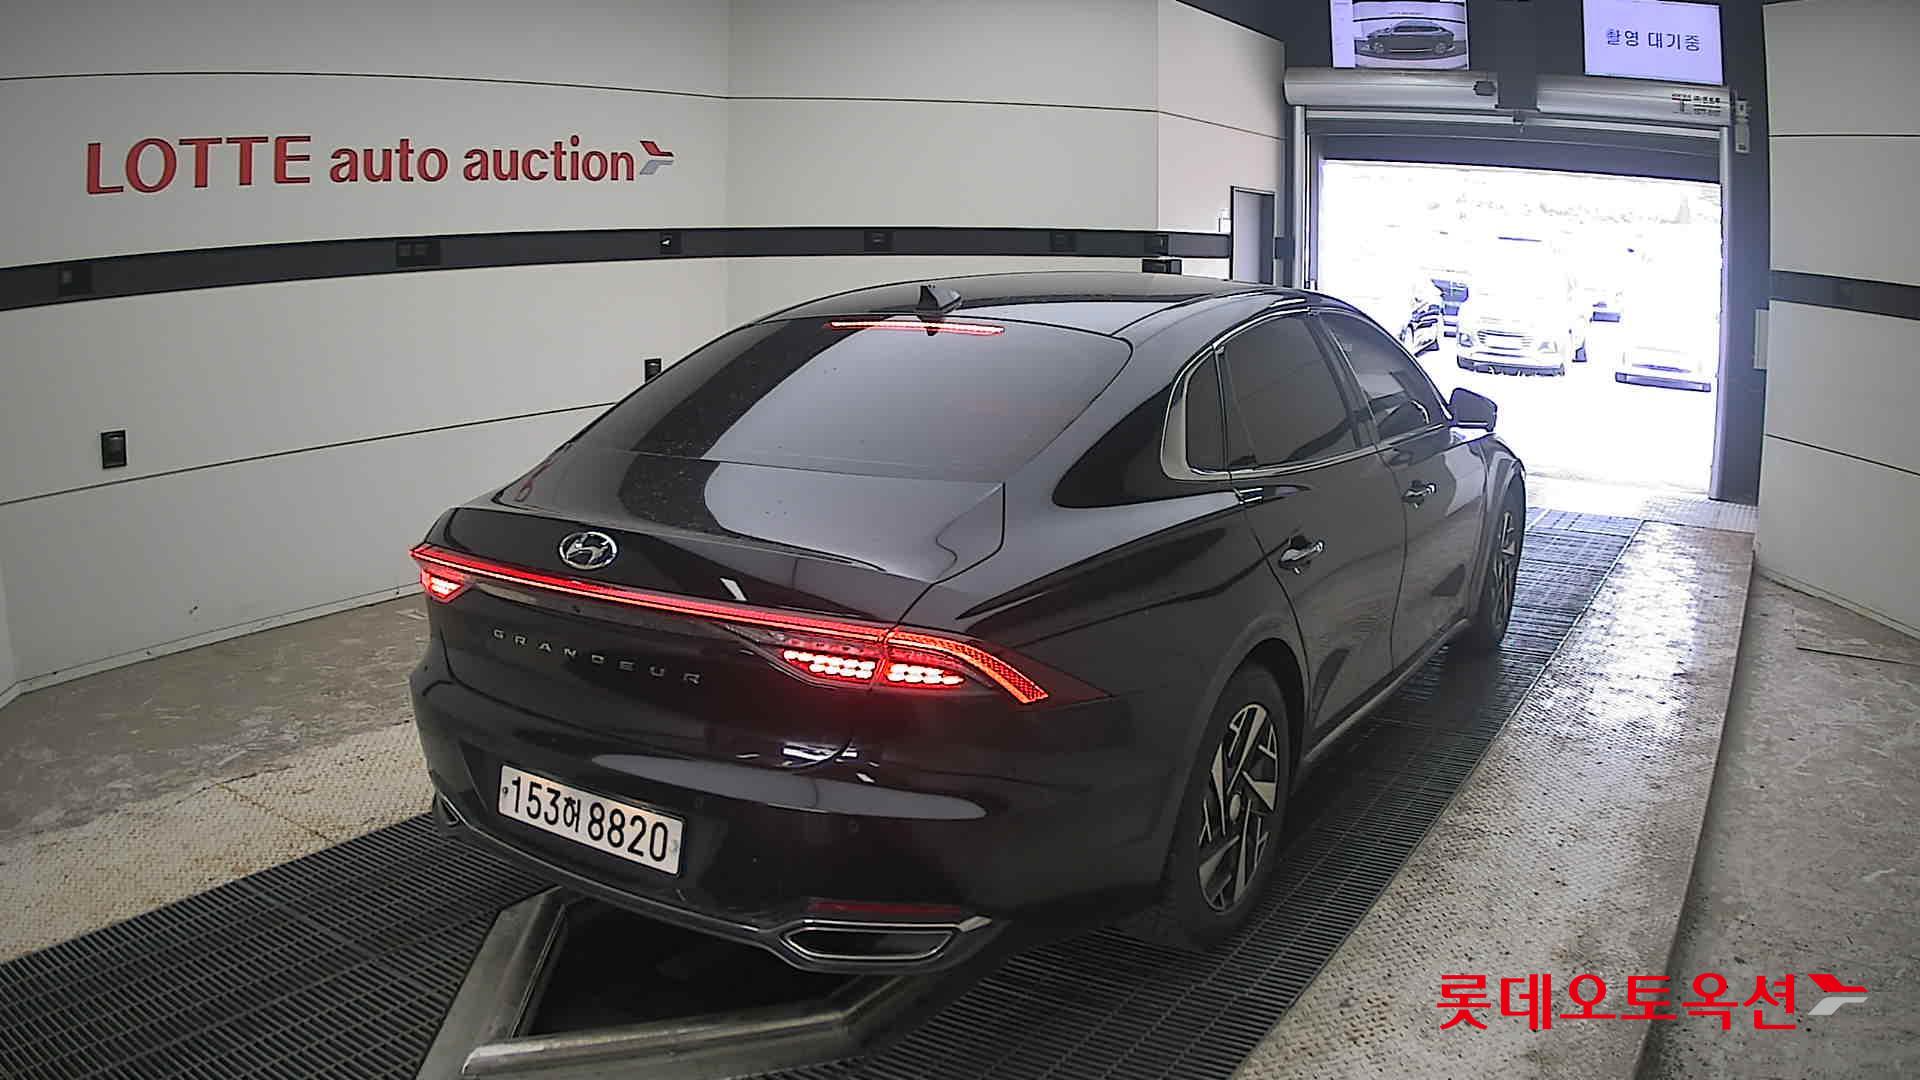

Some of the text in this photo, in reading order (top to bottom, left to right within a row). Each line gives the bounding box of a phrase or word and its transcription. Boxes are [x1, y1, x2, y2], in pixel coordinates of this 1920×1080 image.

[1648, 31, 1701, 52] 대기중
[86, 135, 635, 195] LOTTE auto auction
[493, 628, 701, 685] GRANDEUR
